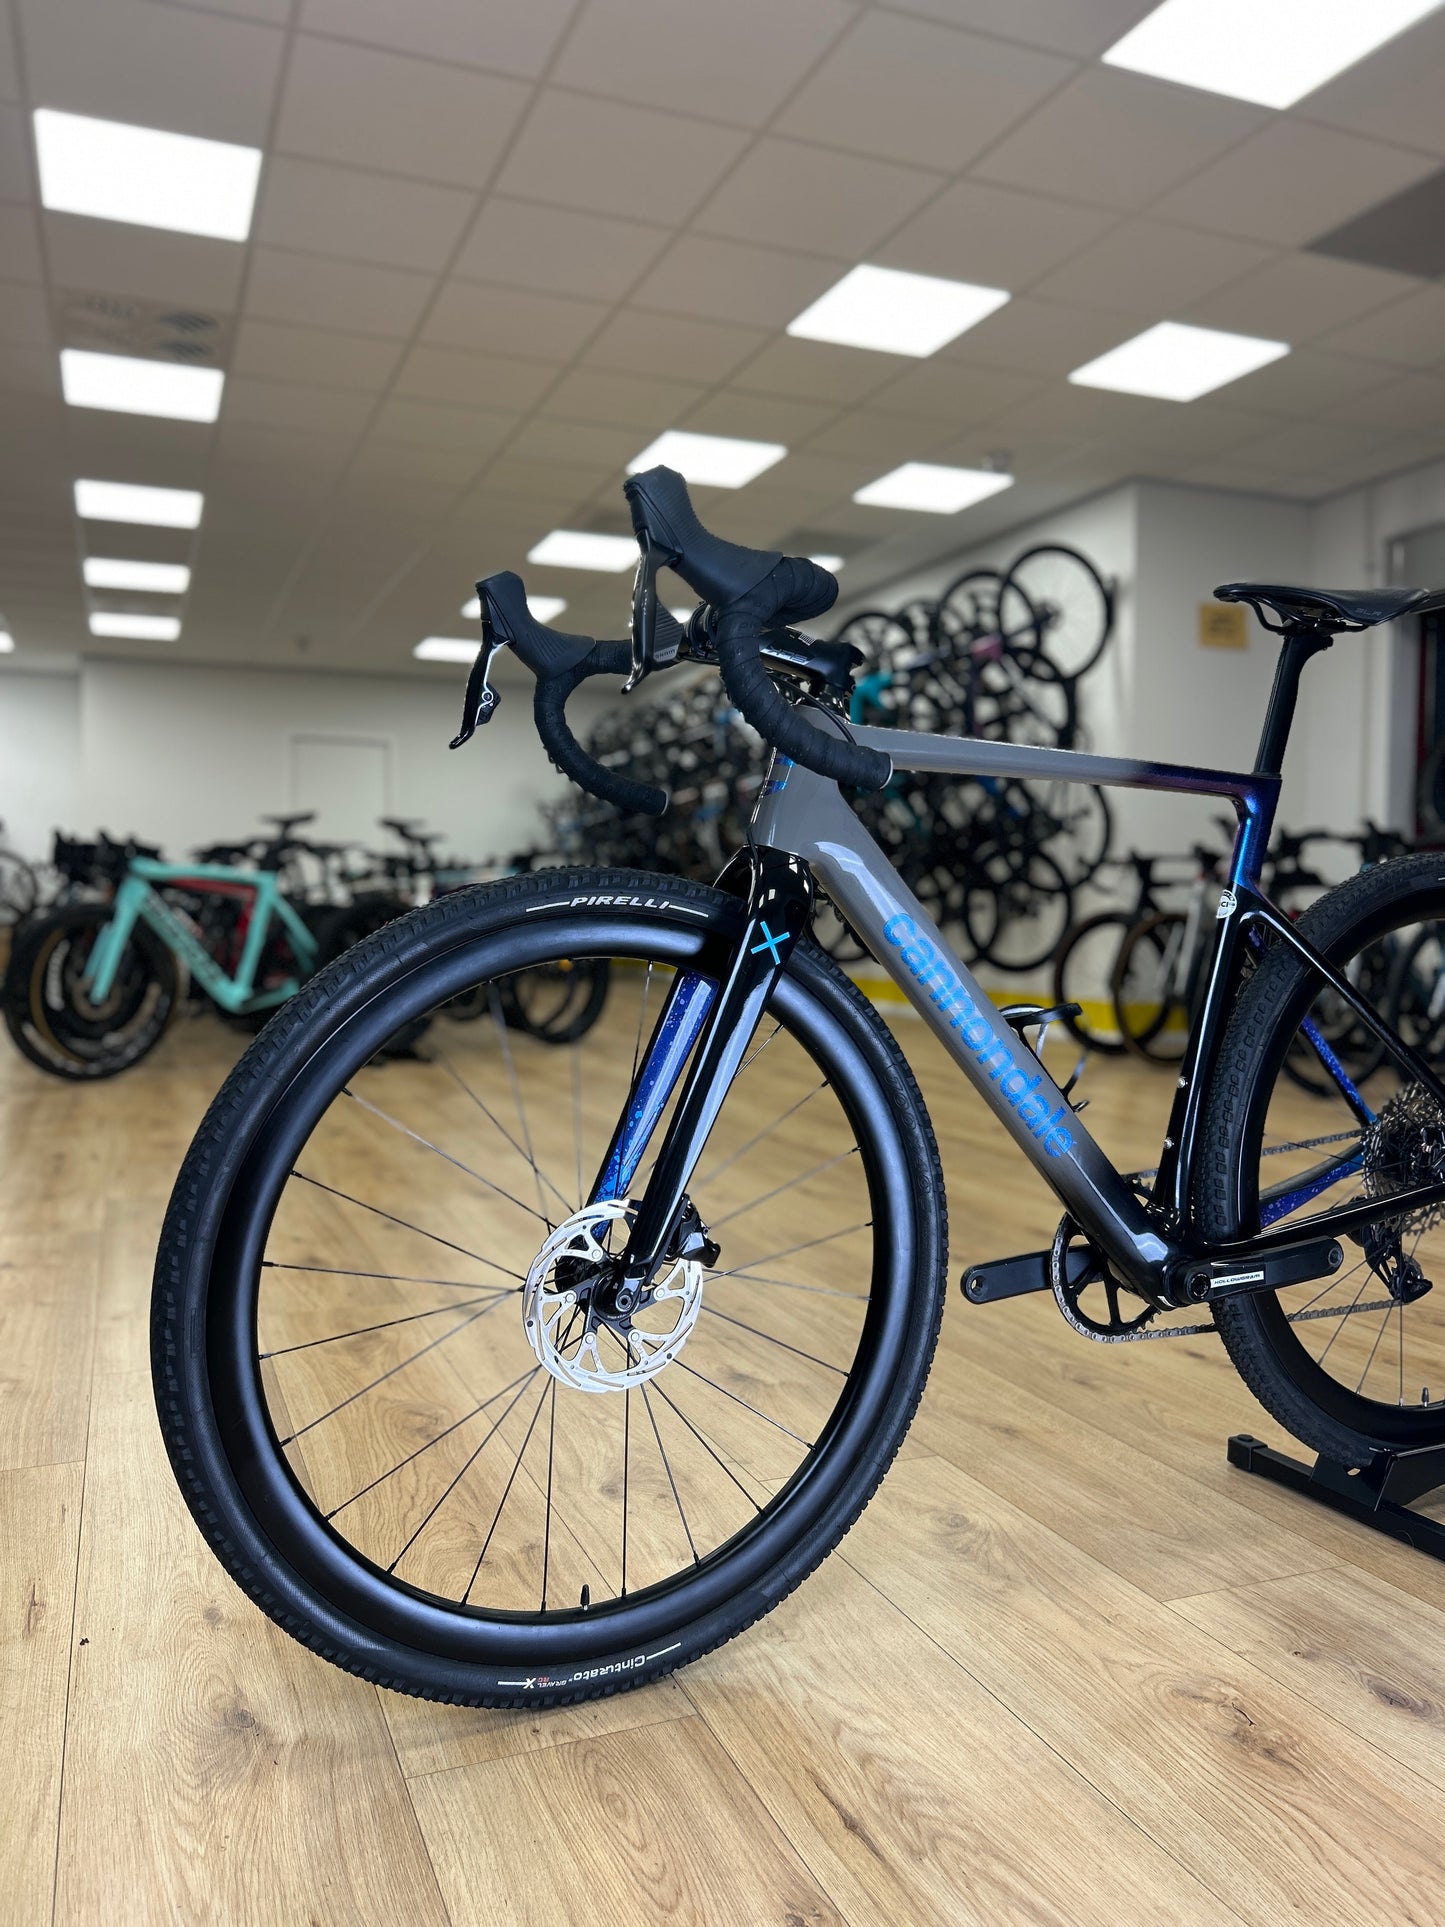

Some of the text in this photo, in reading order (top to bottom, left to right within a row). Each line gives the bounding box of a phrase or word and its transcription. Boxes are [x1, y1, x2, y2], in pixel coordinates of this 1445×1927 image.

[569, 896, 670, 909] PIRELLI
[883, 912, 1074, 1158] cannondale
[573, 1654, 646, 1681] Cinturato
